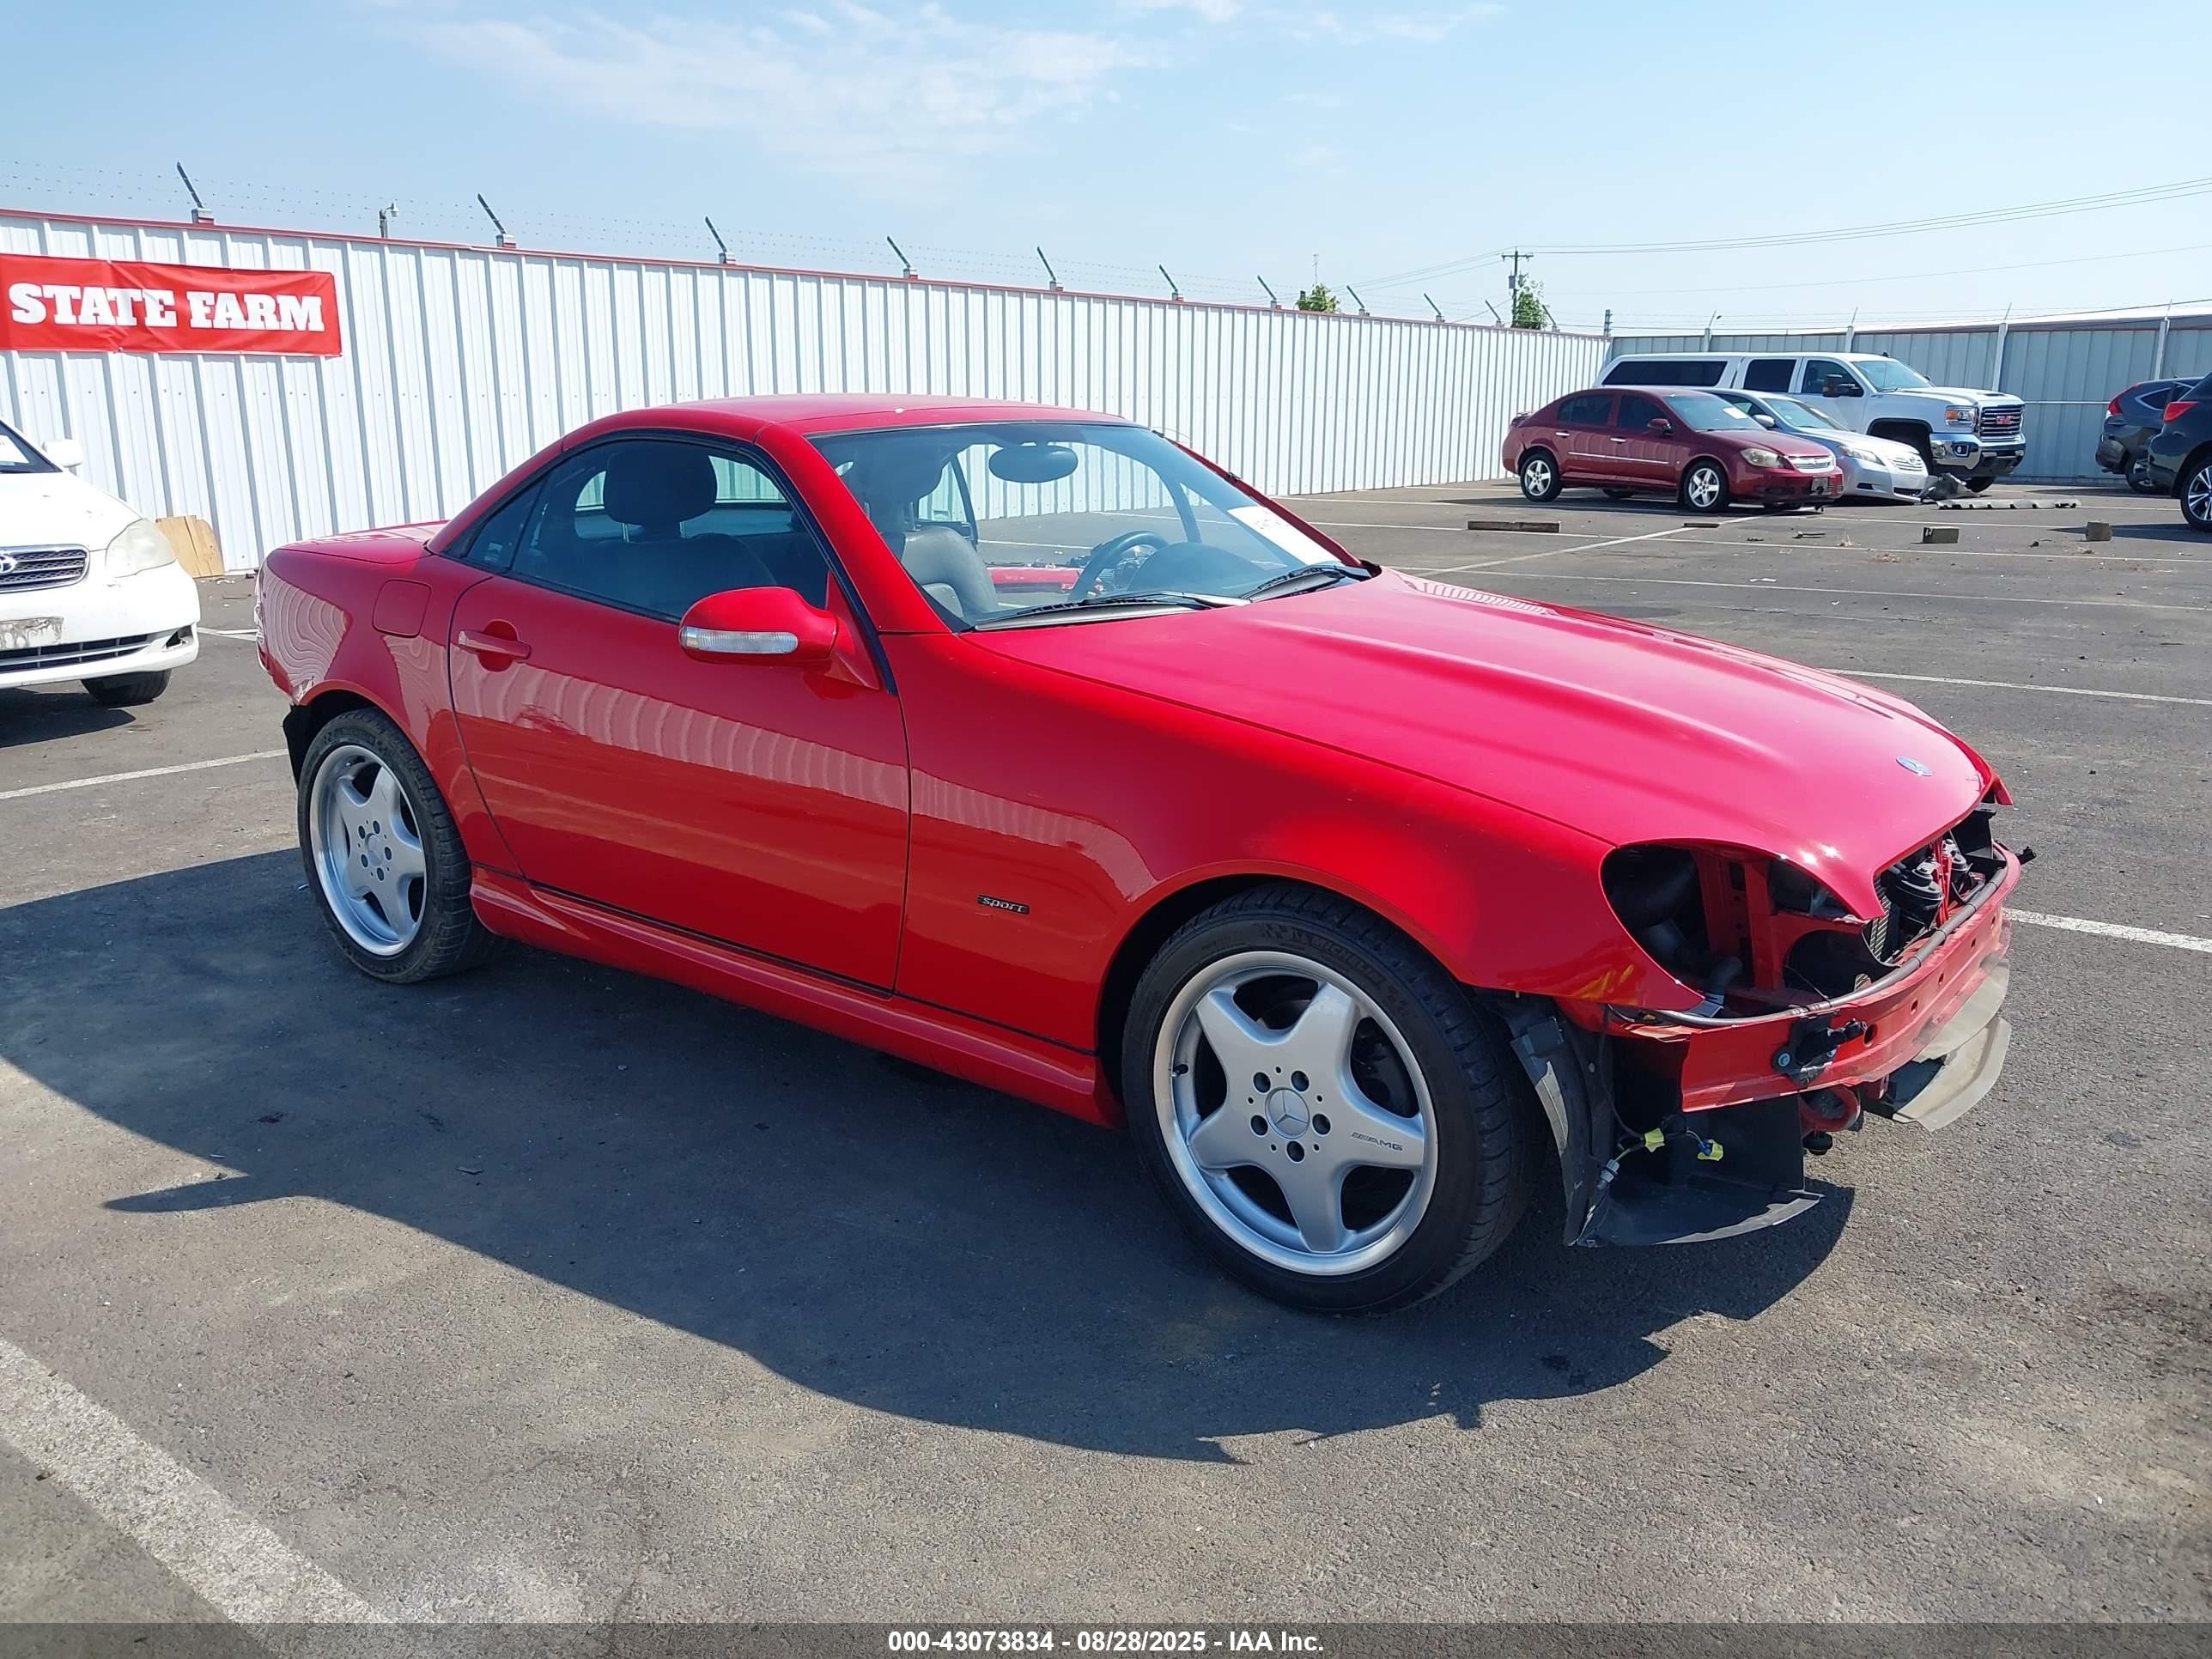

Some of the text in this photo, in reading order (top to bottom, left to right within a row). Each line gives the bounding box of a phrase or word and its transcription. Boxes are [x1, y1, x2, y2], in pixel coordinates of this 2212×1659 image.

[8, 283, 326, 332] STATE FARM
[1365, 1135, 1403, 1152] AMG
